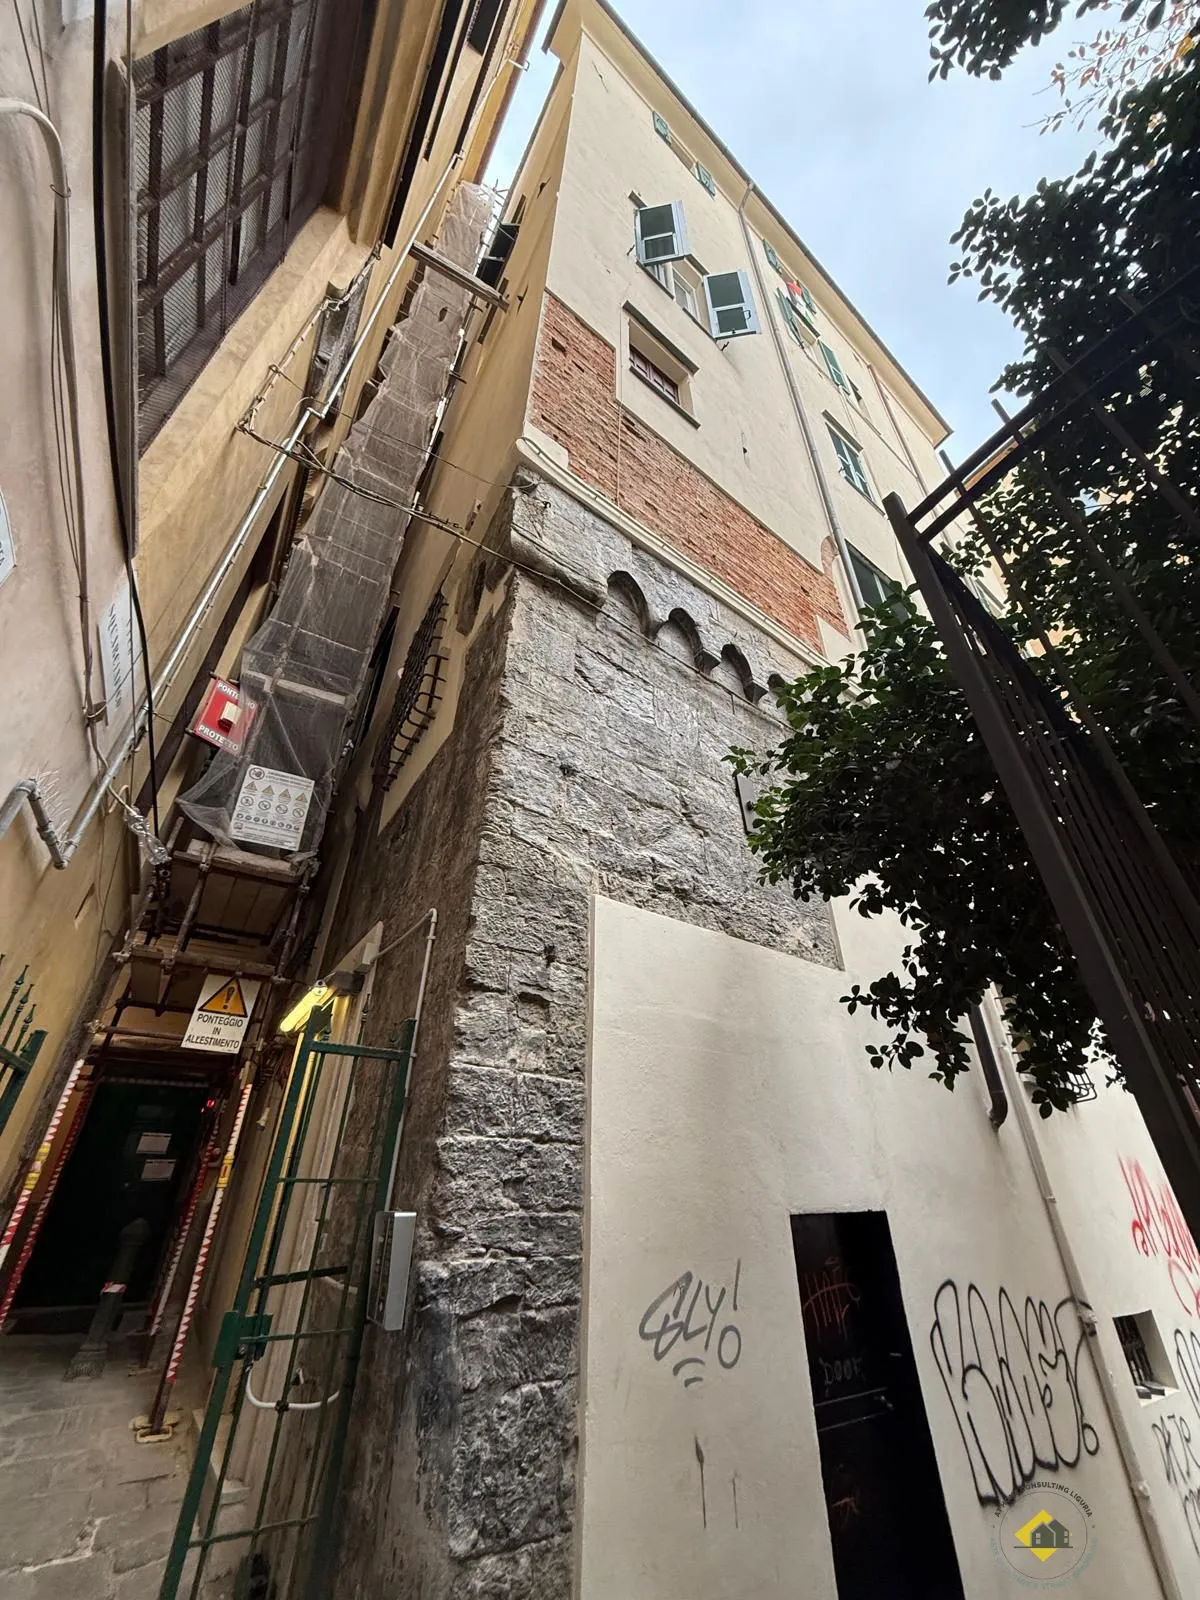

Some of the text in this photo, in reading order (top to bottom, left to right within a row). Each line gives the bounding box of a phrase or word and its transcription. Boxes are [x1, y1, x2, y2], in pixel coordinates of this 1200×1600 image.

[197, 1014, 244, 1027] PONTEGGIO
[212, 1027, 221, 1035] IN
[186, 1035, 239, 1048] ALLESTIMENTO
